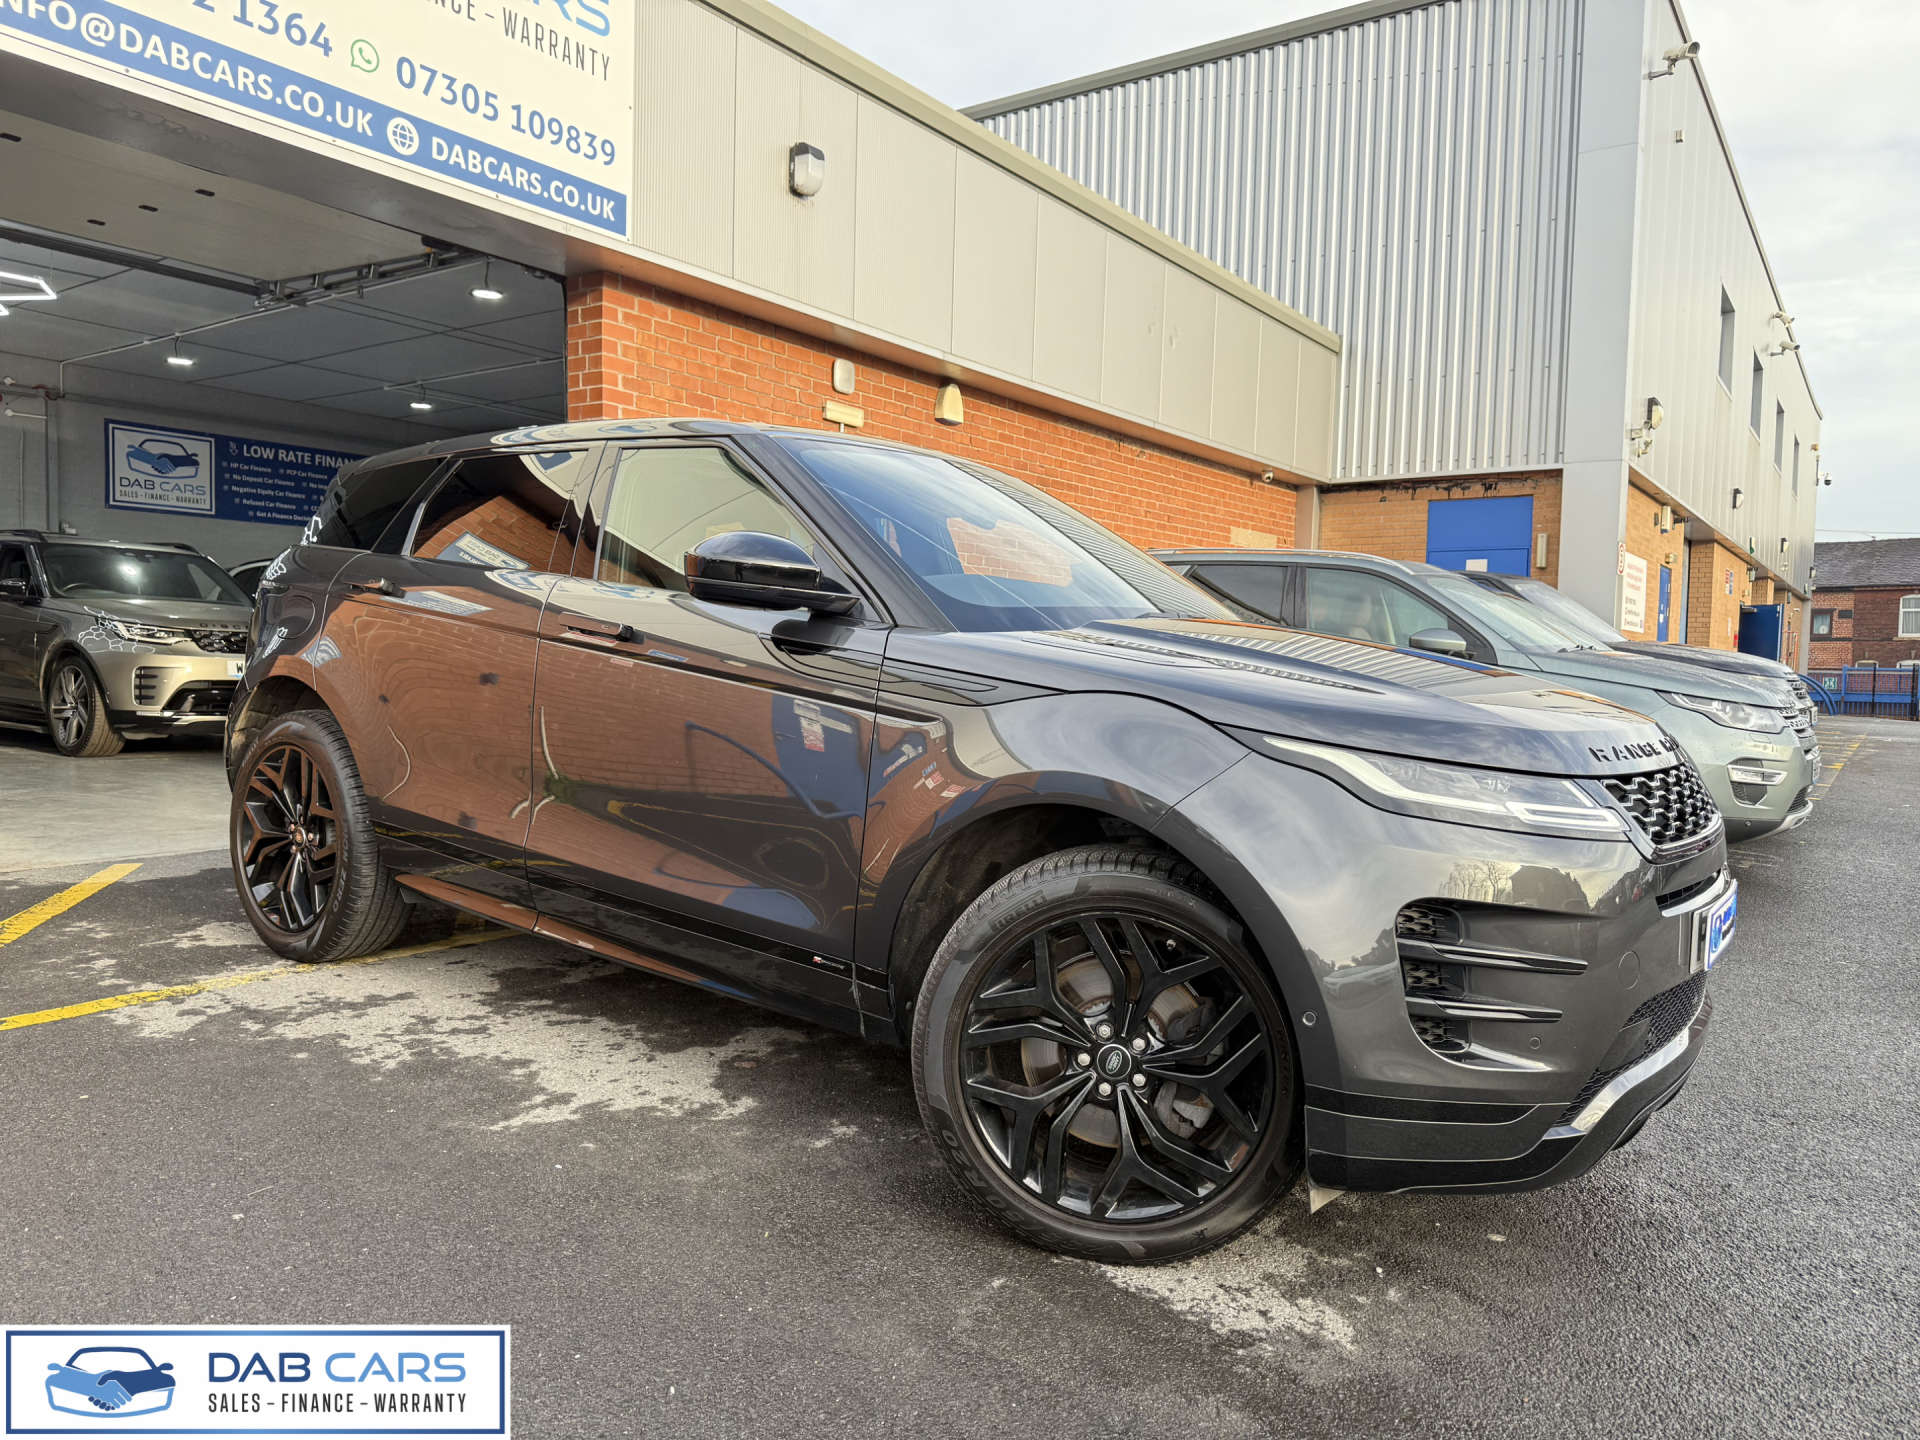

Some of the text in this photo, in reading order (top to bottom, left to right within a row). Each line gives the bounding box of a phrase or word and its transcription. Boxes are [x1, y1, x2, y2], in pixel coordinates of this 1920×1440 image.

[232, 0, 334, 57] 1364
[502, 7, 610, 81] WARRANTY
[396, 56, 616, 166] 07305 109839
[431, 136, 616, 222] DABCARS.CO.UK
[119, 476, 206, 496] DAB CARS
[243, 444, 275, 460] LOW
[278, 449, 312, 465] RATE
